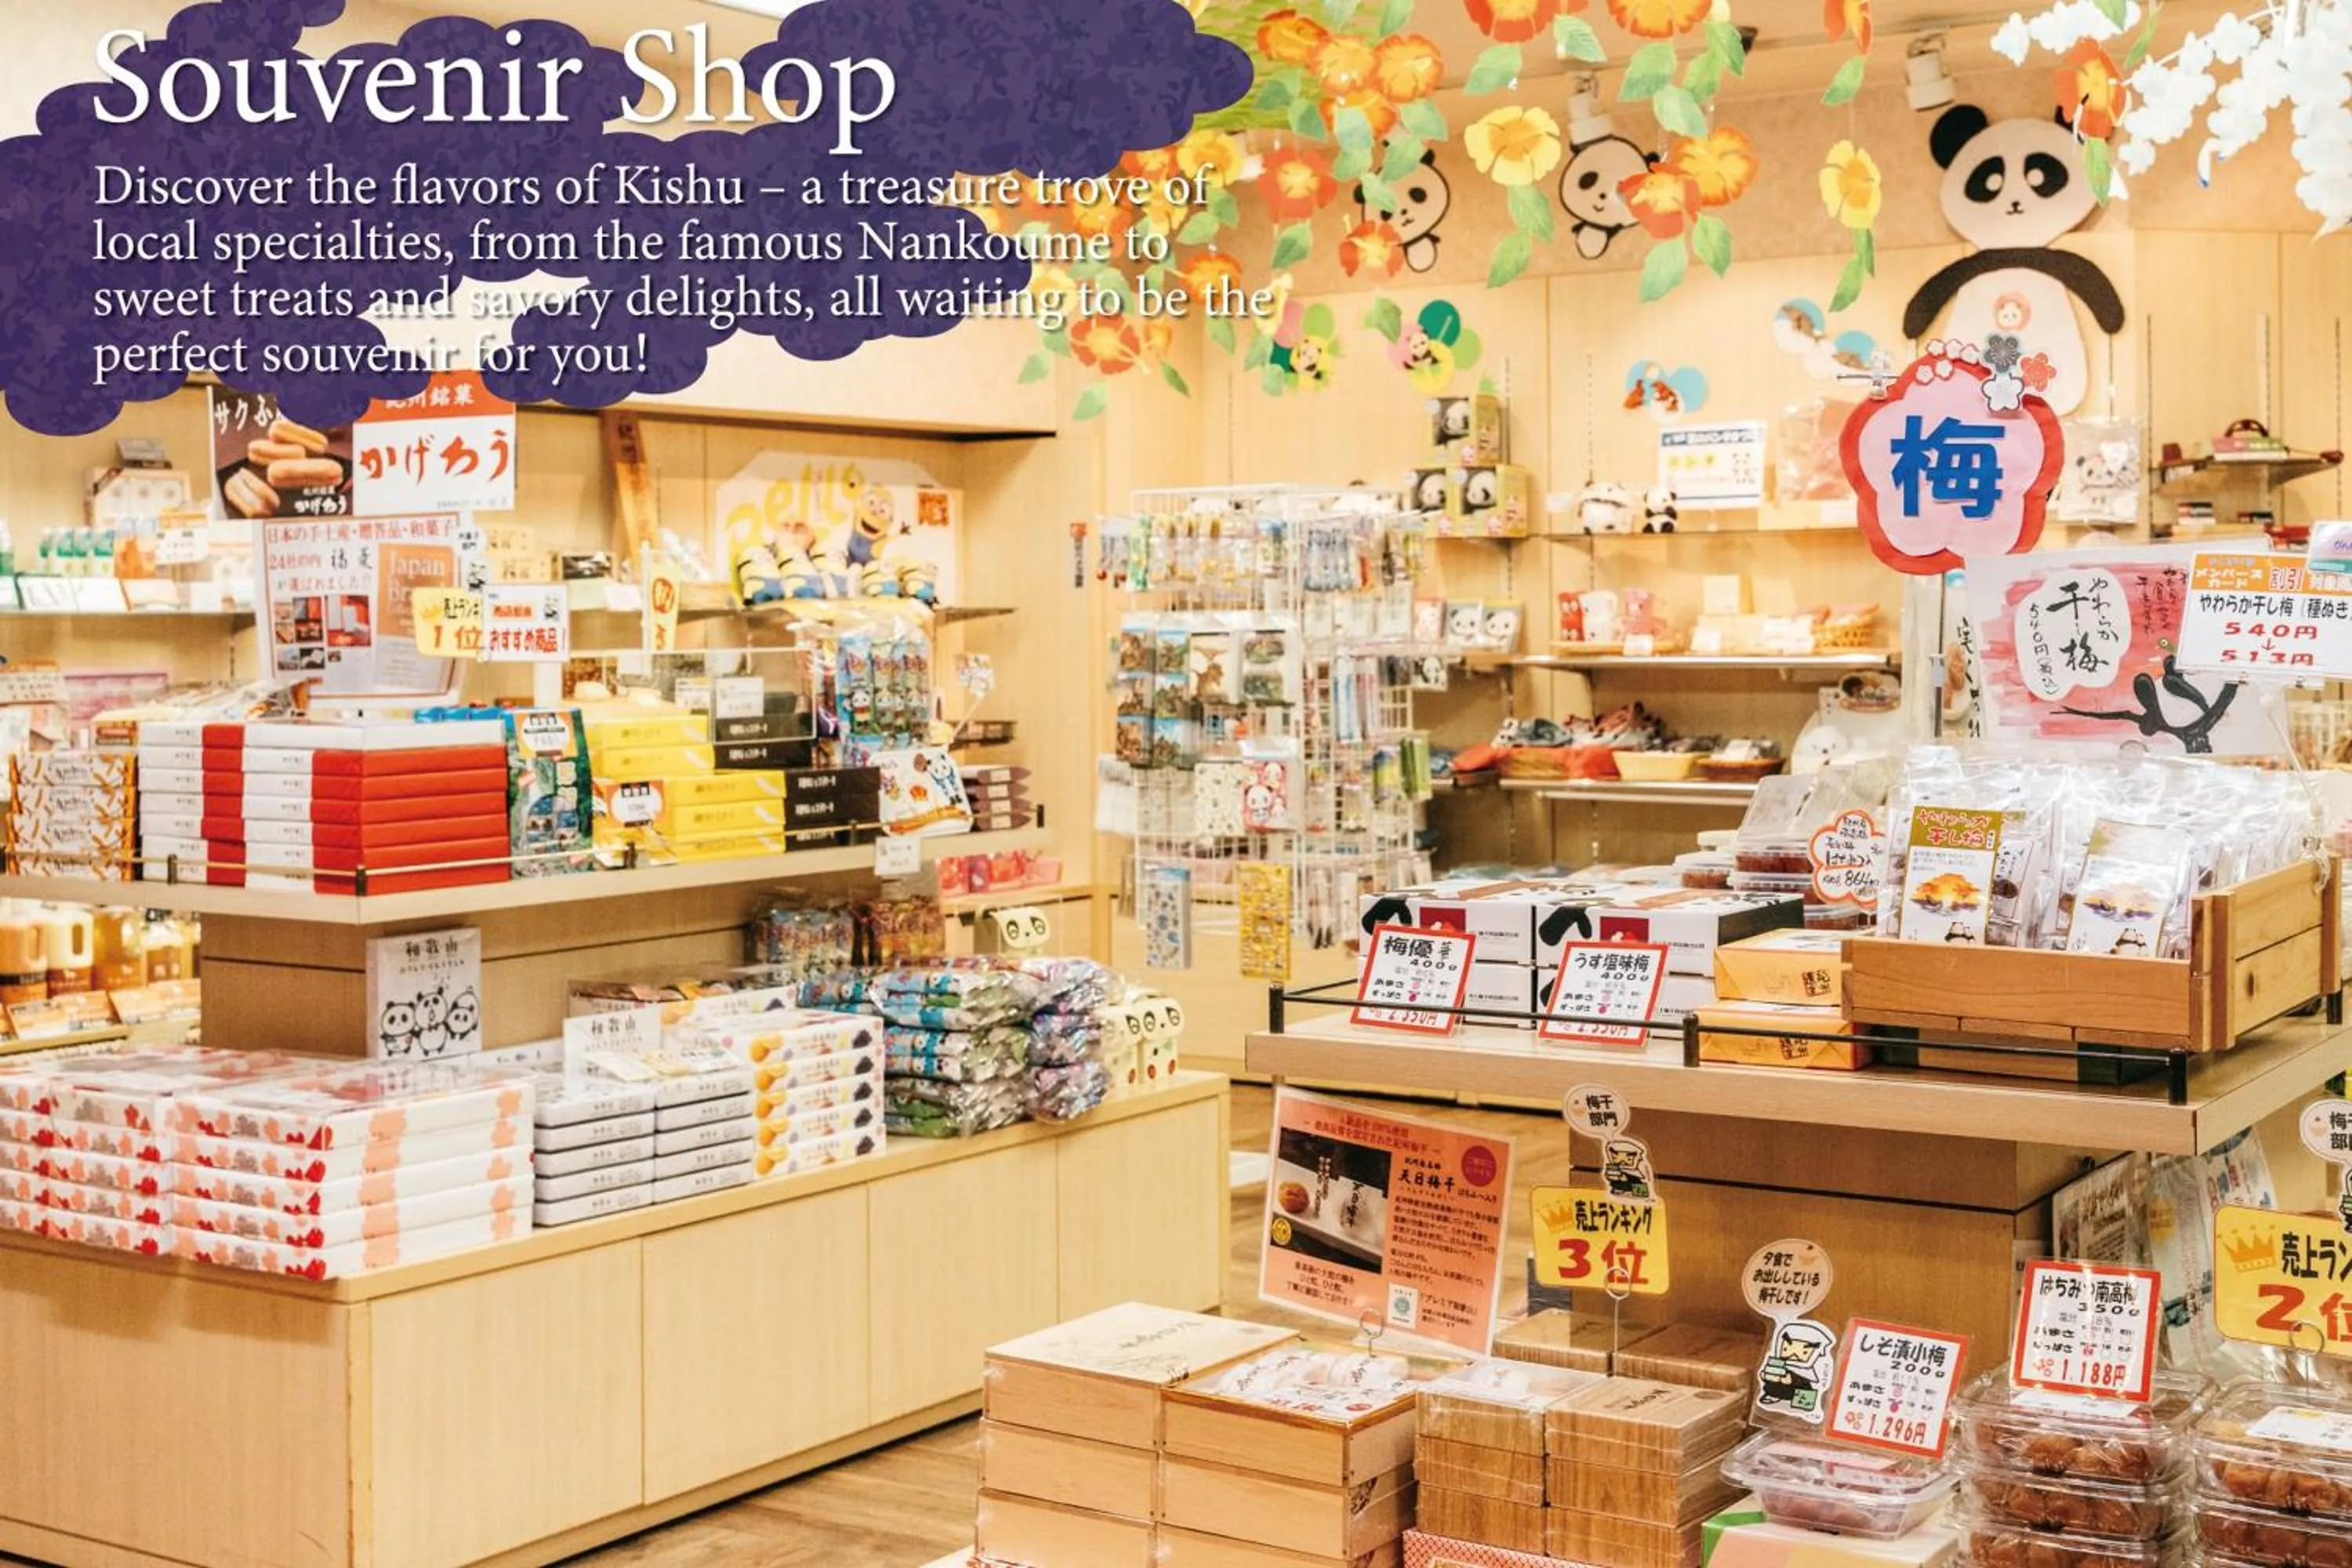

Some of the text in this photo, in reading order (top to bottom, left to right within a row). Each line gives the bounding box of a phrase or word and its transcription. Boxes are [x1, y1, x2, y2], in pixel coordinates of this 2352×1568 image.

[1890, 415, 2005, 521] 梅
[389, 549, 445, 580] Japan
[2207, 578, 2249, 589] カード
[2270, 567, 2304, 591] 割引
[2224, 621, 2318, 640] 540円
[2220, 649, 2314, 666] 513円
[1926, 827, 1986, 848] 干し梅
[1574, 952, 1650, 973] うす塩味梅
[1585, 1094, 1613, 1110] 梅干
[1589, 1111, 1618, 1127] 部門
[1397, 1168, 1457, 1192] 天日梅干
[1575, 1200, 1653, 1234] 売上ランキング
[1557, 1237, 1650, 1285] 3位
[1763, 1251, 1794, 1268] 夕食で
[1752, 1269, 1820, 1287] お出ししている
[1759, 1289, 1809, 1306] 梅干しです!
[1859, 1333, 1948, 1368] しそ漬小梅
[1849, 1381, 1885, 1396] あまさ
